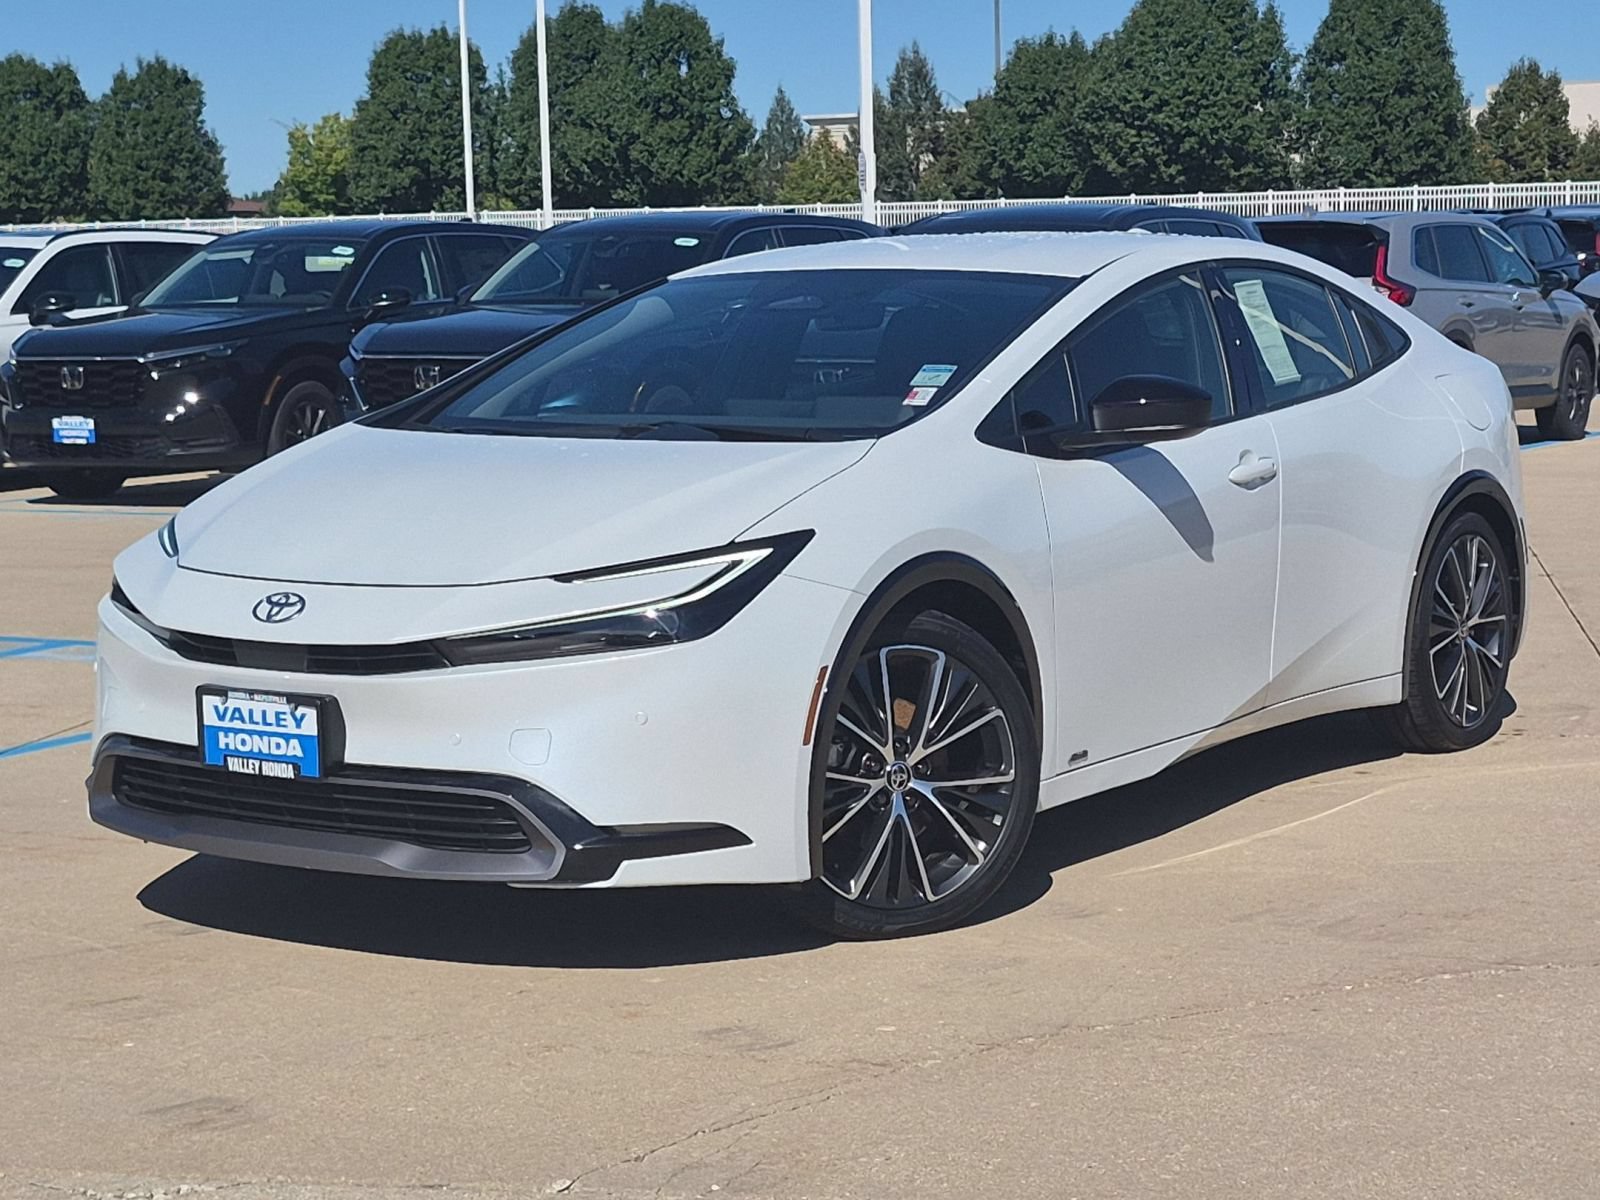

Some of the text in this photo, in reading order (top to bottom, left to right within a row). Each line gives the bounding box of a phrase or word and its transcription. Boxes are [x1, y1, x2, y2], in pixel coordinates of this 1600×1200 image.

[212, 704, 307, 730] VALLEY
[218, 731, 304, 758] HONDA
[226, 756, 295, 779] VALLEY HONDA
